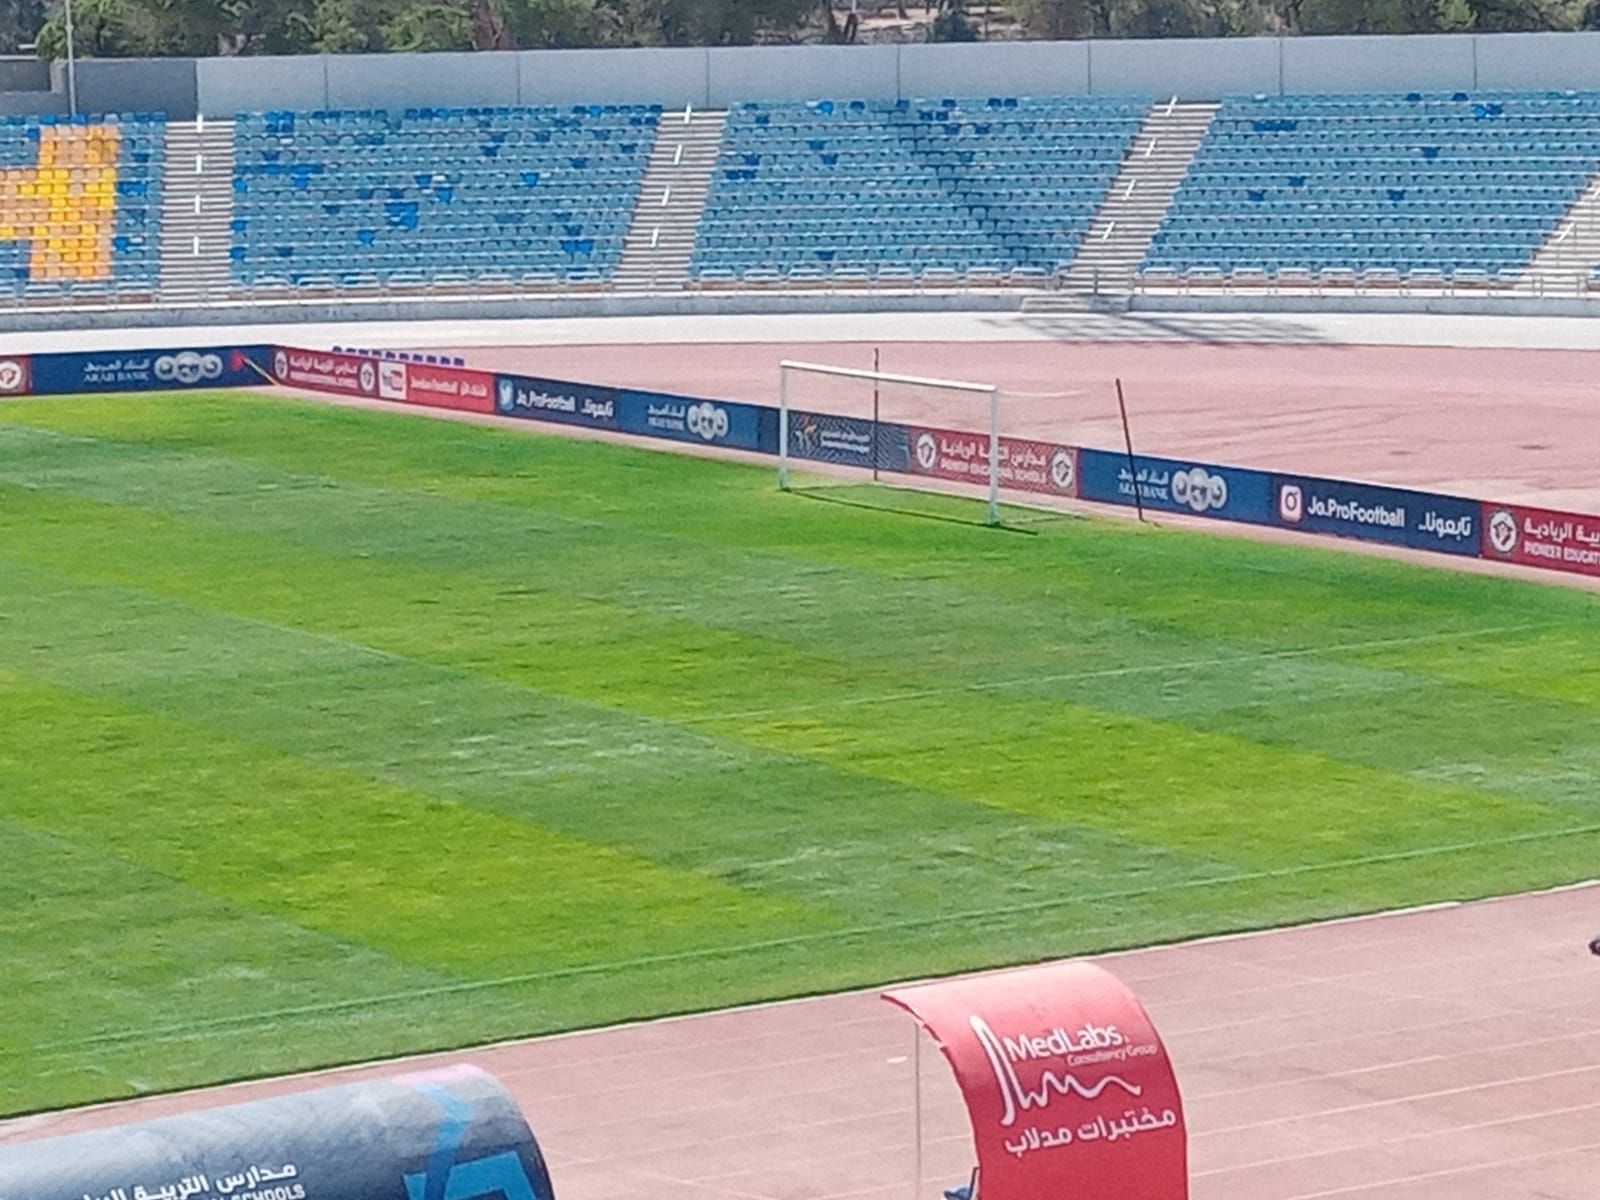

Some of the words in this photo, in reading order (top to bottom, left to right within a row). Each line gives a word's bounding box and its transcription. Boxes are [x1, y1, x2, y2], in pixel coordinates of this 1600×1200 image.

[1308, 496, 1405, 528] Jo.ProFootball
[1523, 541, 1562, 560] PIONEER
[1003, 1024, 1124, 1062] MedLabs
[1078, 1108, 1177, 1141] مختبرات
[1004, 1127, 1072, 1158] مدلاب
[216, 1164, 297, 1193] مدارس
